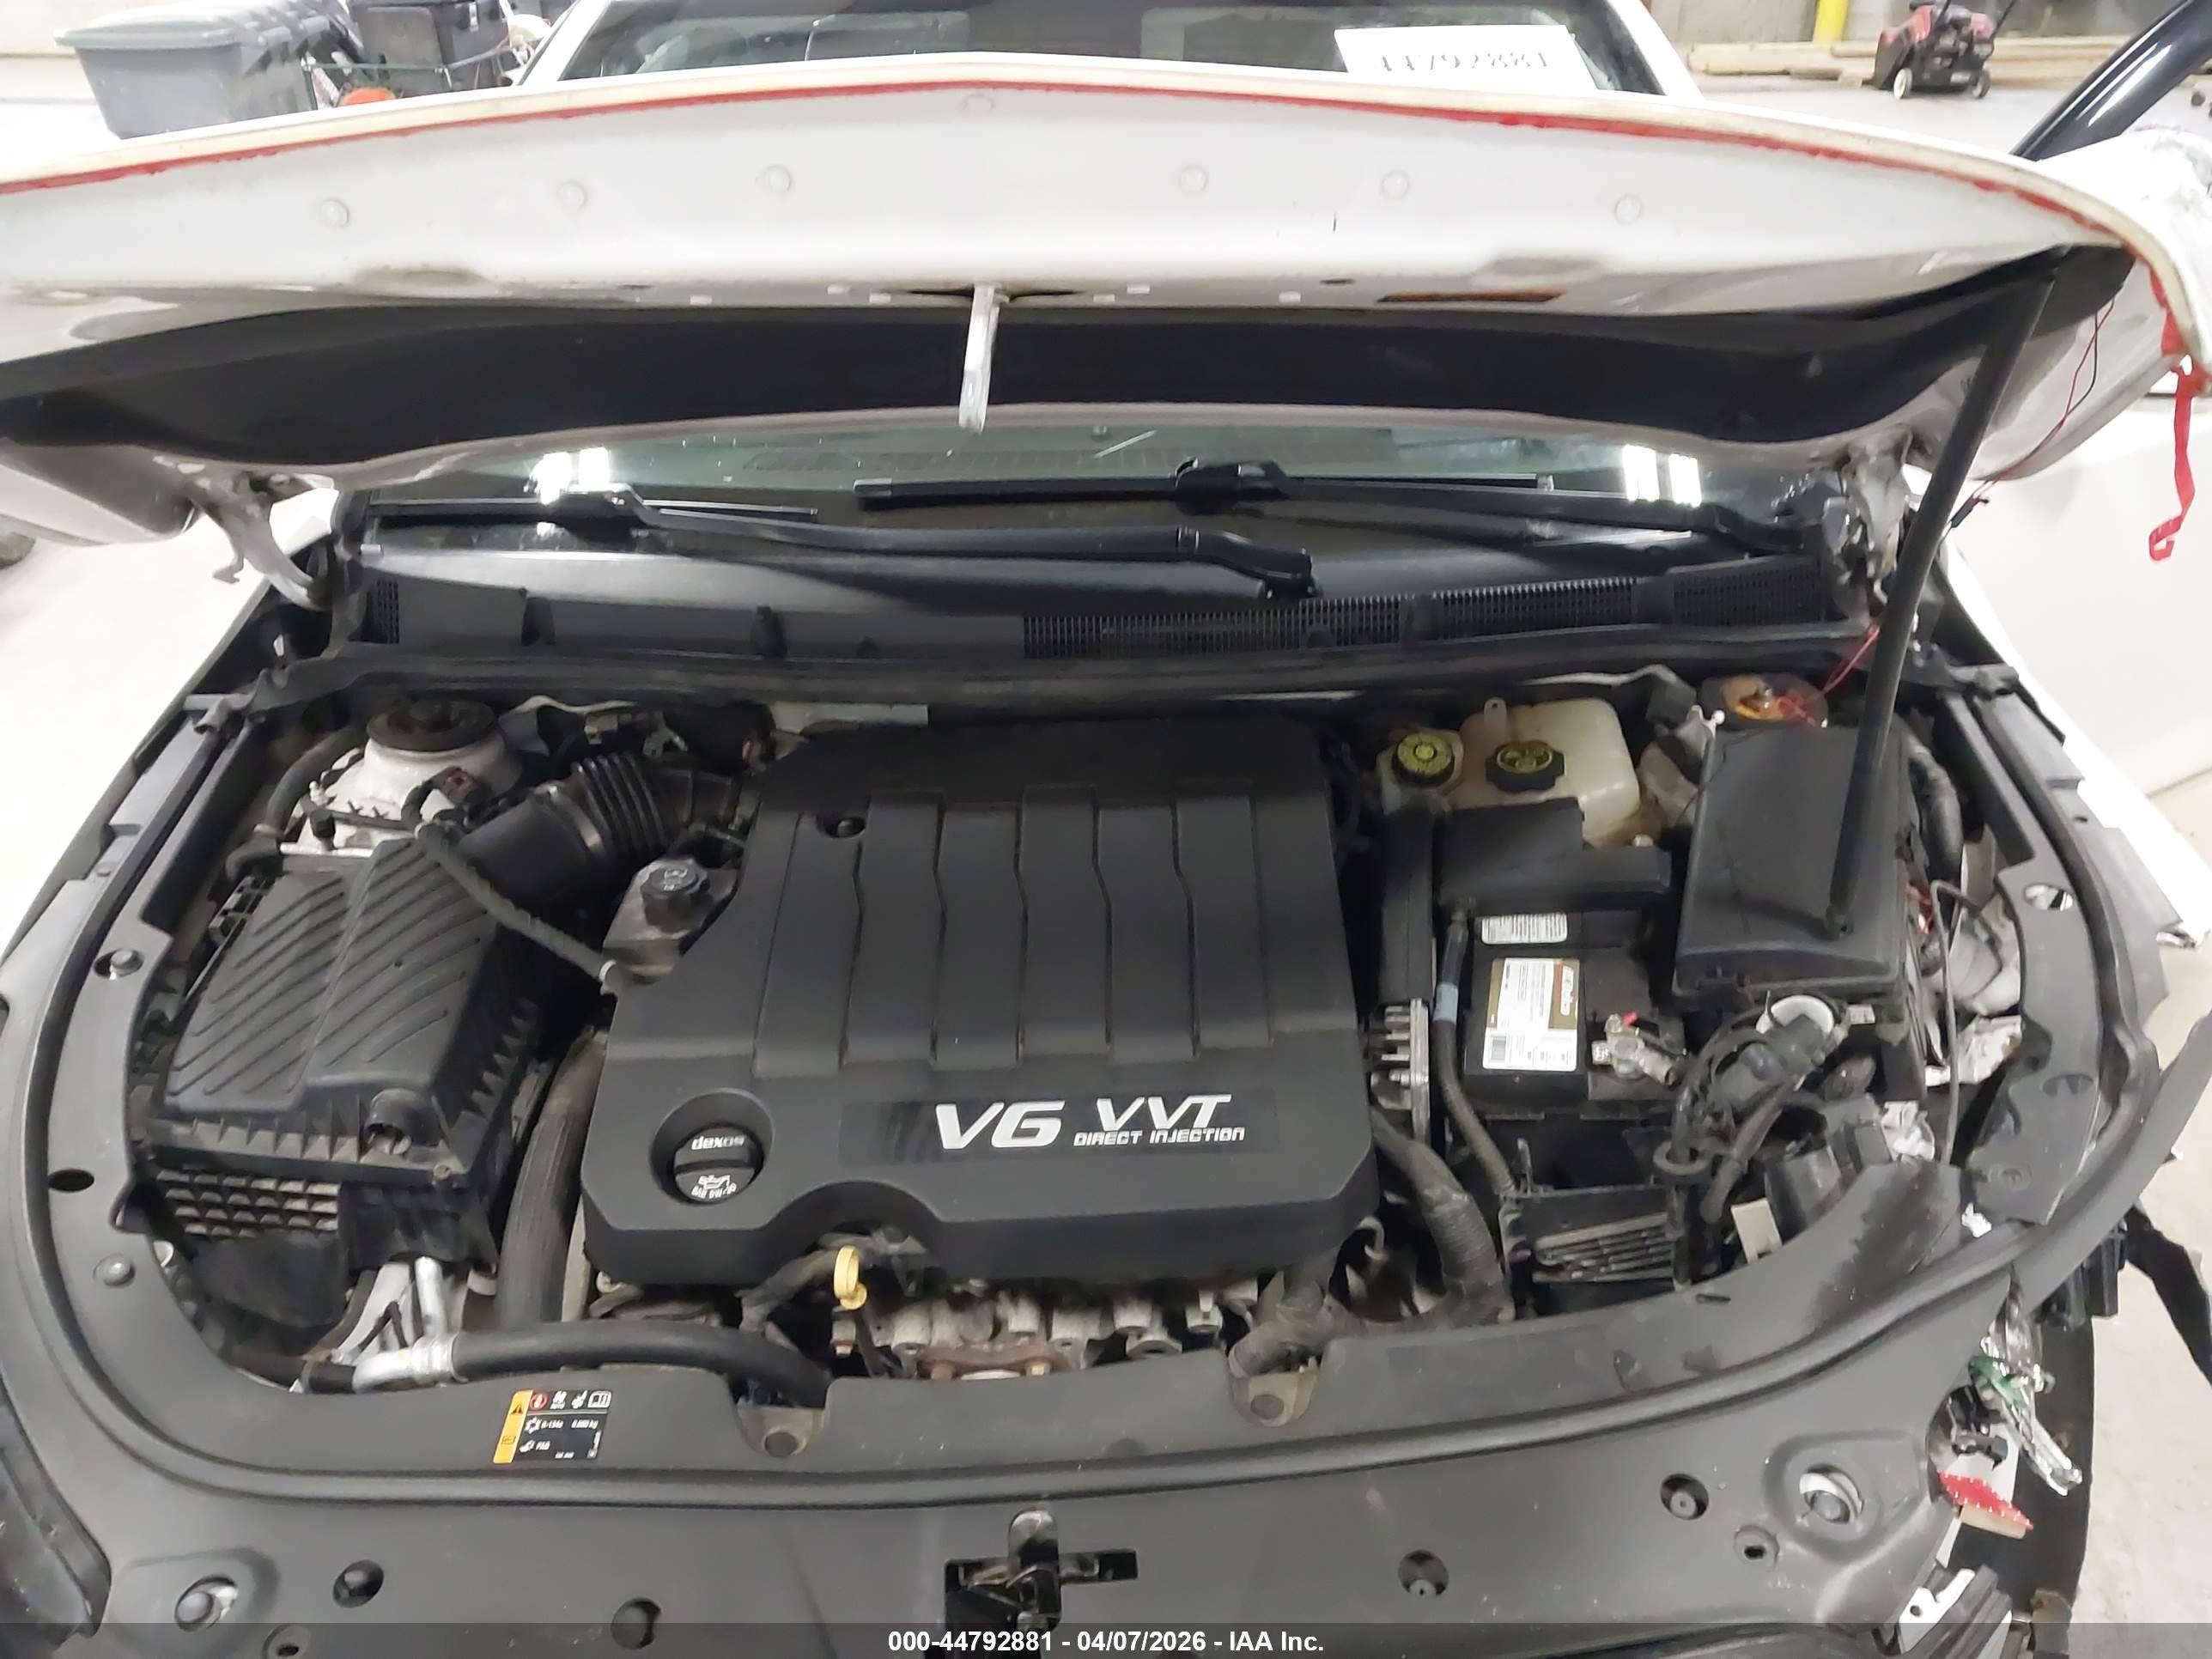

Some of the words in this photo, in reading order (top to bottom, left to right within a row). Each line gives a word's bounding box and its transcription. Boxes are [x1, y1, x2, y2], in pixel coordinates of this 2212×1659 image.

[935, 1100, 1066, 1150] V6
[1097, 1093, 1232, 1131] VVT
[1073, 1128, 1143, 1146] DIRECT
[1149, 1126, 1245, 1145] INJECTION
